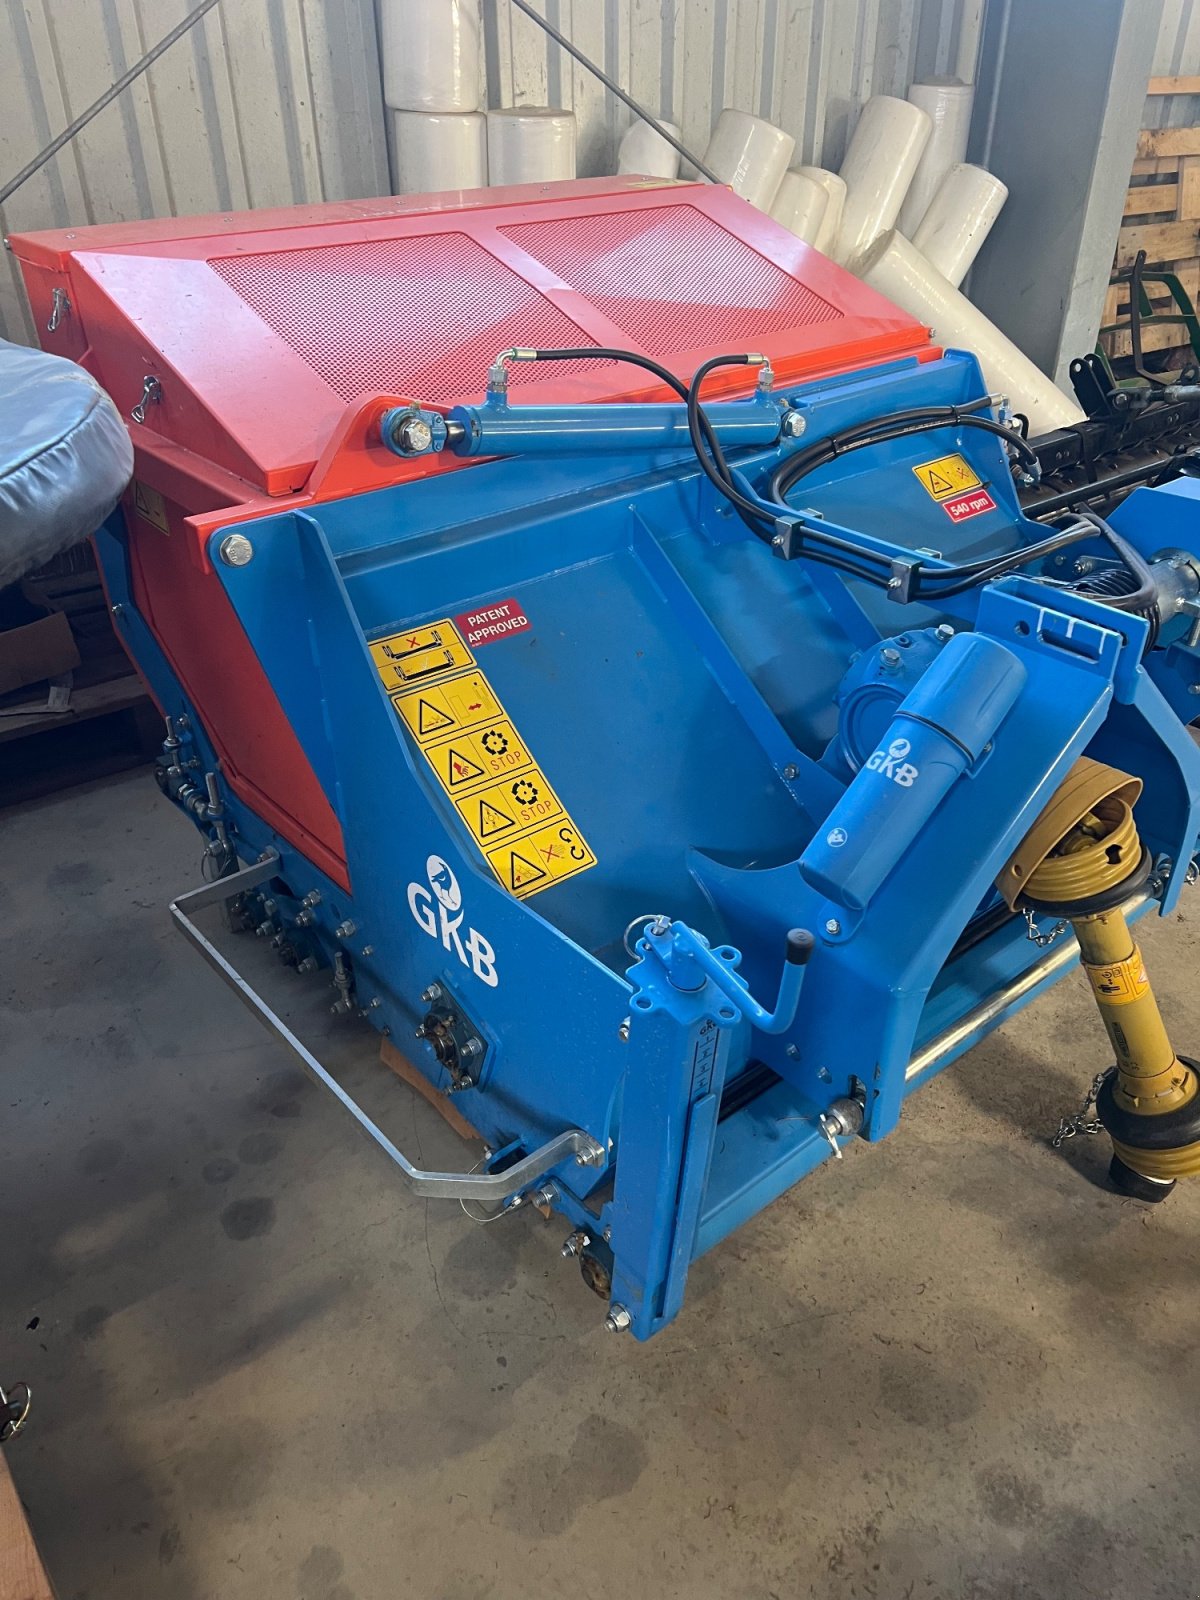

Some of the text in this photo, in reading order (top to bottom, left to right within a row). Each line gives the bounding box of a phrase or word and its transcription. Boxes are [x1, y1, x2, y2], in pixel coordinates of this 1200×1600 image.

[950, 497, 989, 516] 540 rpm
[467, 605, 511, 627] PATENT
[467, 615, 528, 643] APPROVED
[490, 750, 521, 771] STOP
[865, 750, 919, 788] GKB
[520, 800, 552, 821] STOP
[406, 882, 499, 988] GKB
